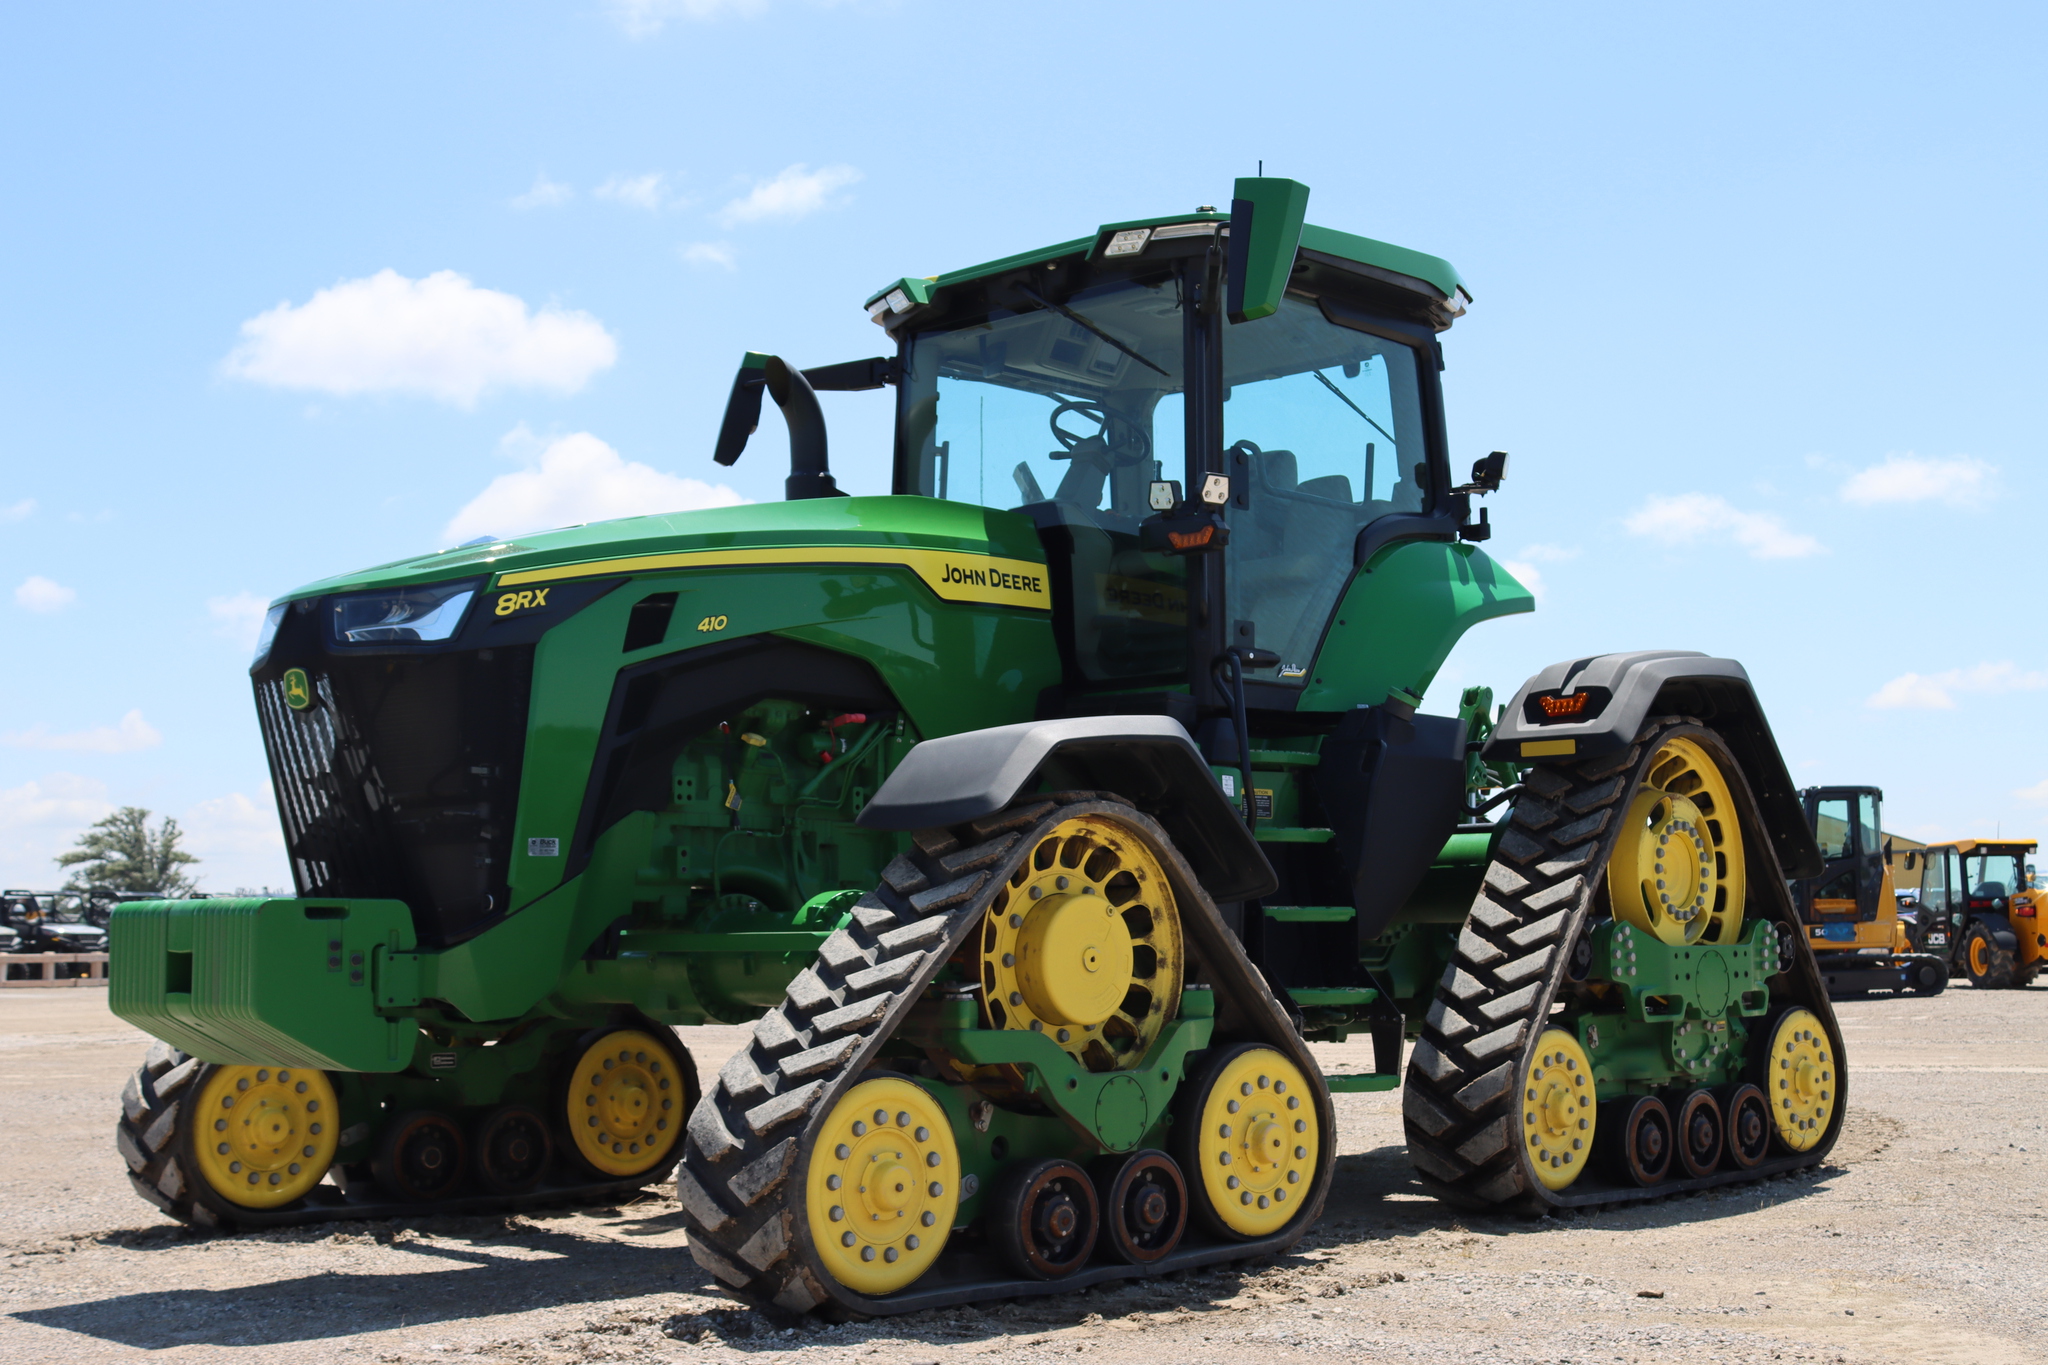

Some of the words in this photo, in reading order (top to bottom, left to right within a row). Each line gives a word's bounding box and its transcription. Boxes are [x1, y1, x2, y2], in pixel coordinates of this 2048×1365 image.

[941, 563, 987, 587] JOHN
[988, 567, 1042, 593] DEERE
[494, 587, 550, 616] 8RX
[696, 615, 728, 633] 410
[1927, 933, 1946, 945] JCB
